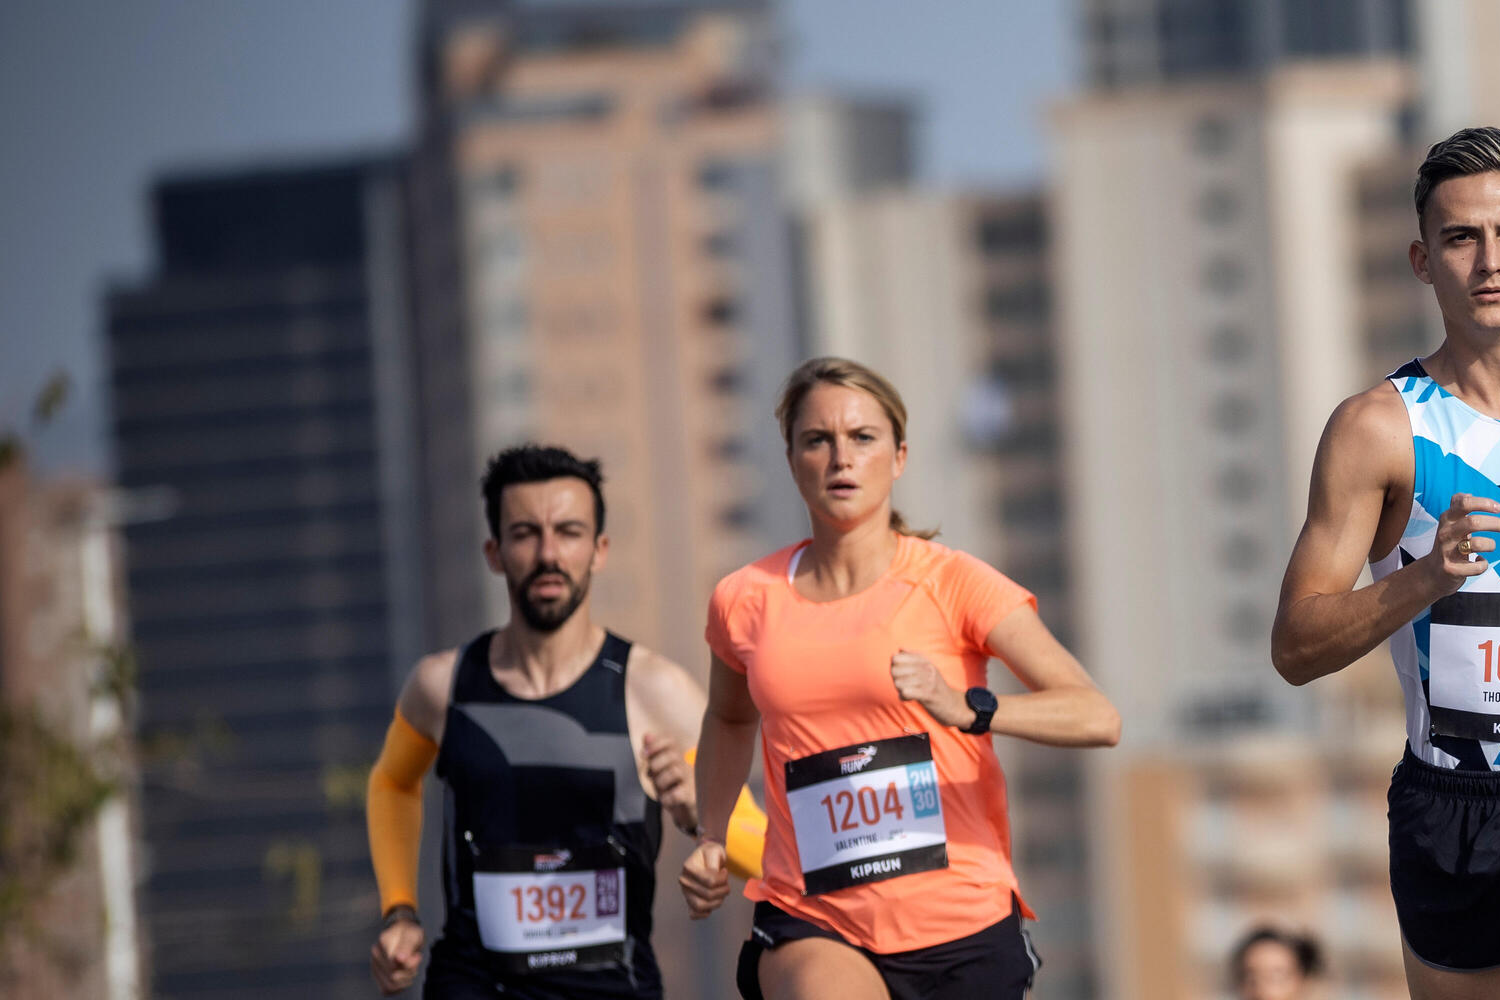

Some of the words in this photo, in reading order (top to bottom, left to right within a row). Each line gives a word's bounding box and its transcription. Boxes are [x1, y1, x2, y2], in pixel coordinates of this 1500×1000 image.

[840, 761, 863, 774] RUN
[909, 771, 933, 791] 2H
[820, 781, 905, 834] 1204
[914, 789, 936, 812] 30
[834, 832, 878, 851] VALENTINE
[850, 857, 902, 879] KIPRUN
[510, 883, 588, 923] 1392
